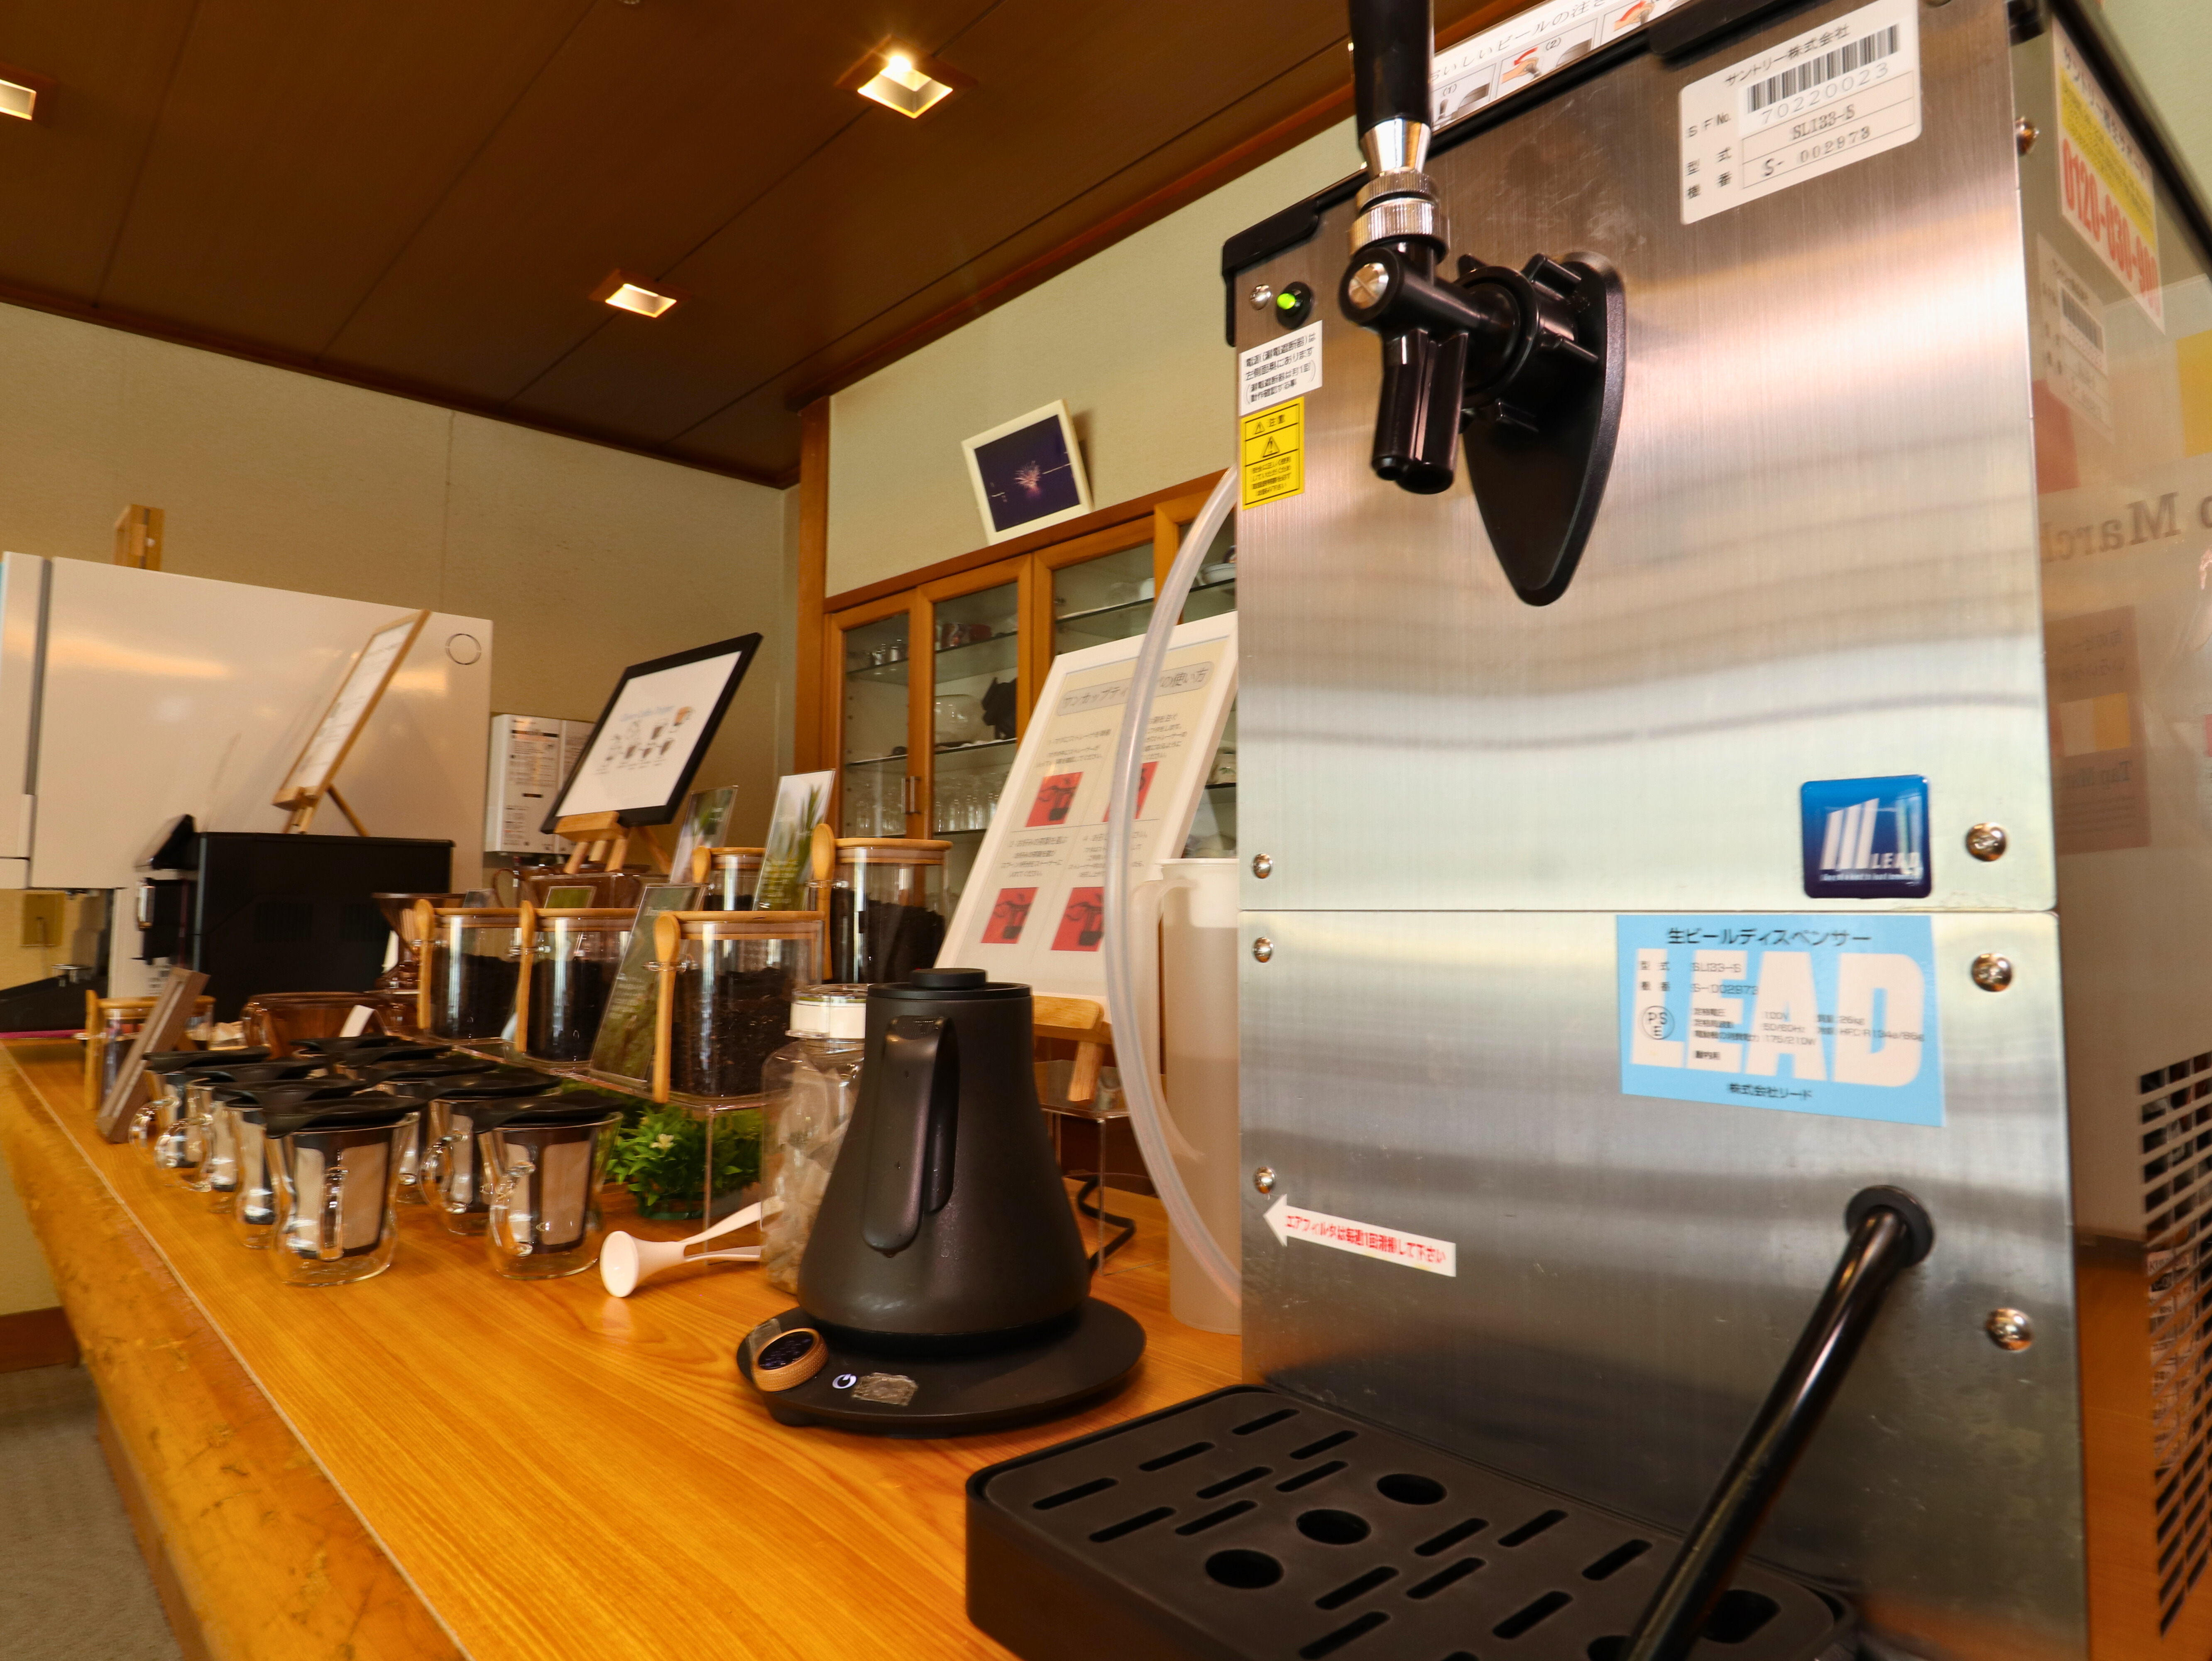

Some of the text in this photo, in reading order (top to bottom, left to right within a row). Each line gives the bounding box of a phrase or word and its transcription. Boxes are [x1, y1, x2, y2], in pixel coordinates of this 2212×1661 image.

[1725, 24, 1850, 86] サントリー株式会社
[1762, 62, 1888, 124] 70220023
[1668, 927, 1872, 946] 生ビールディスペンサー
[1628, 948, 1925, 1087] LEAD
[1729, 1083, 1813, 1100] 株式会社リード
